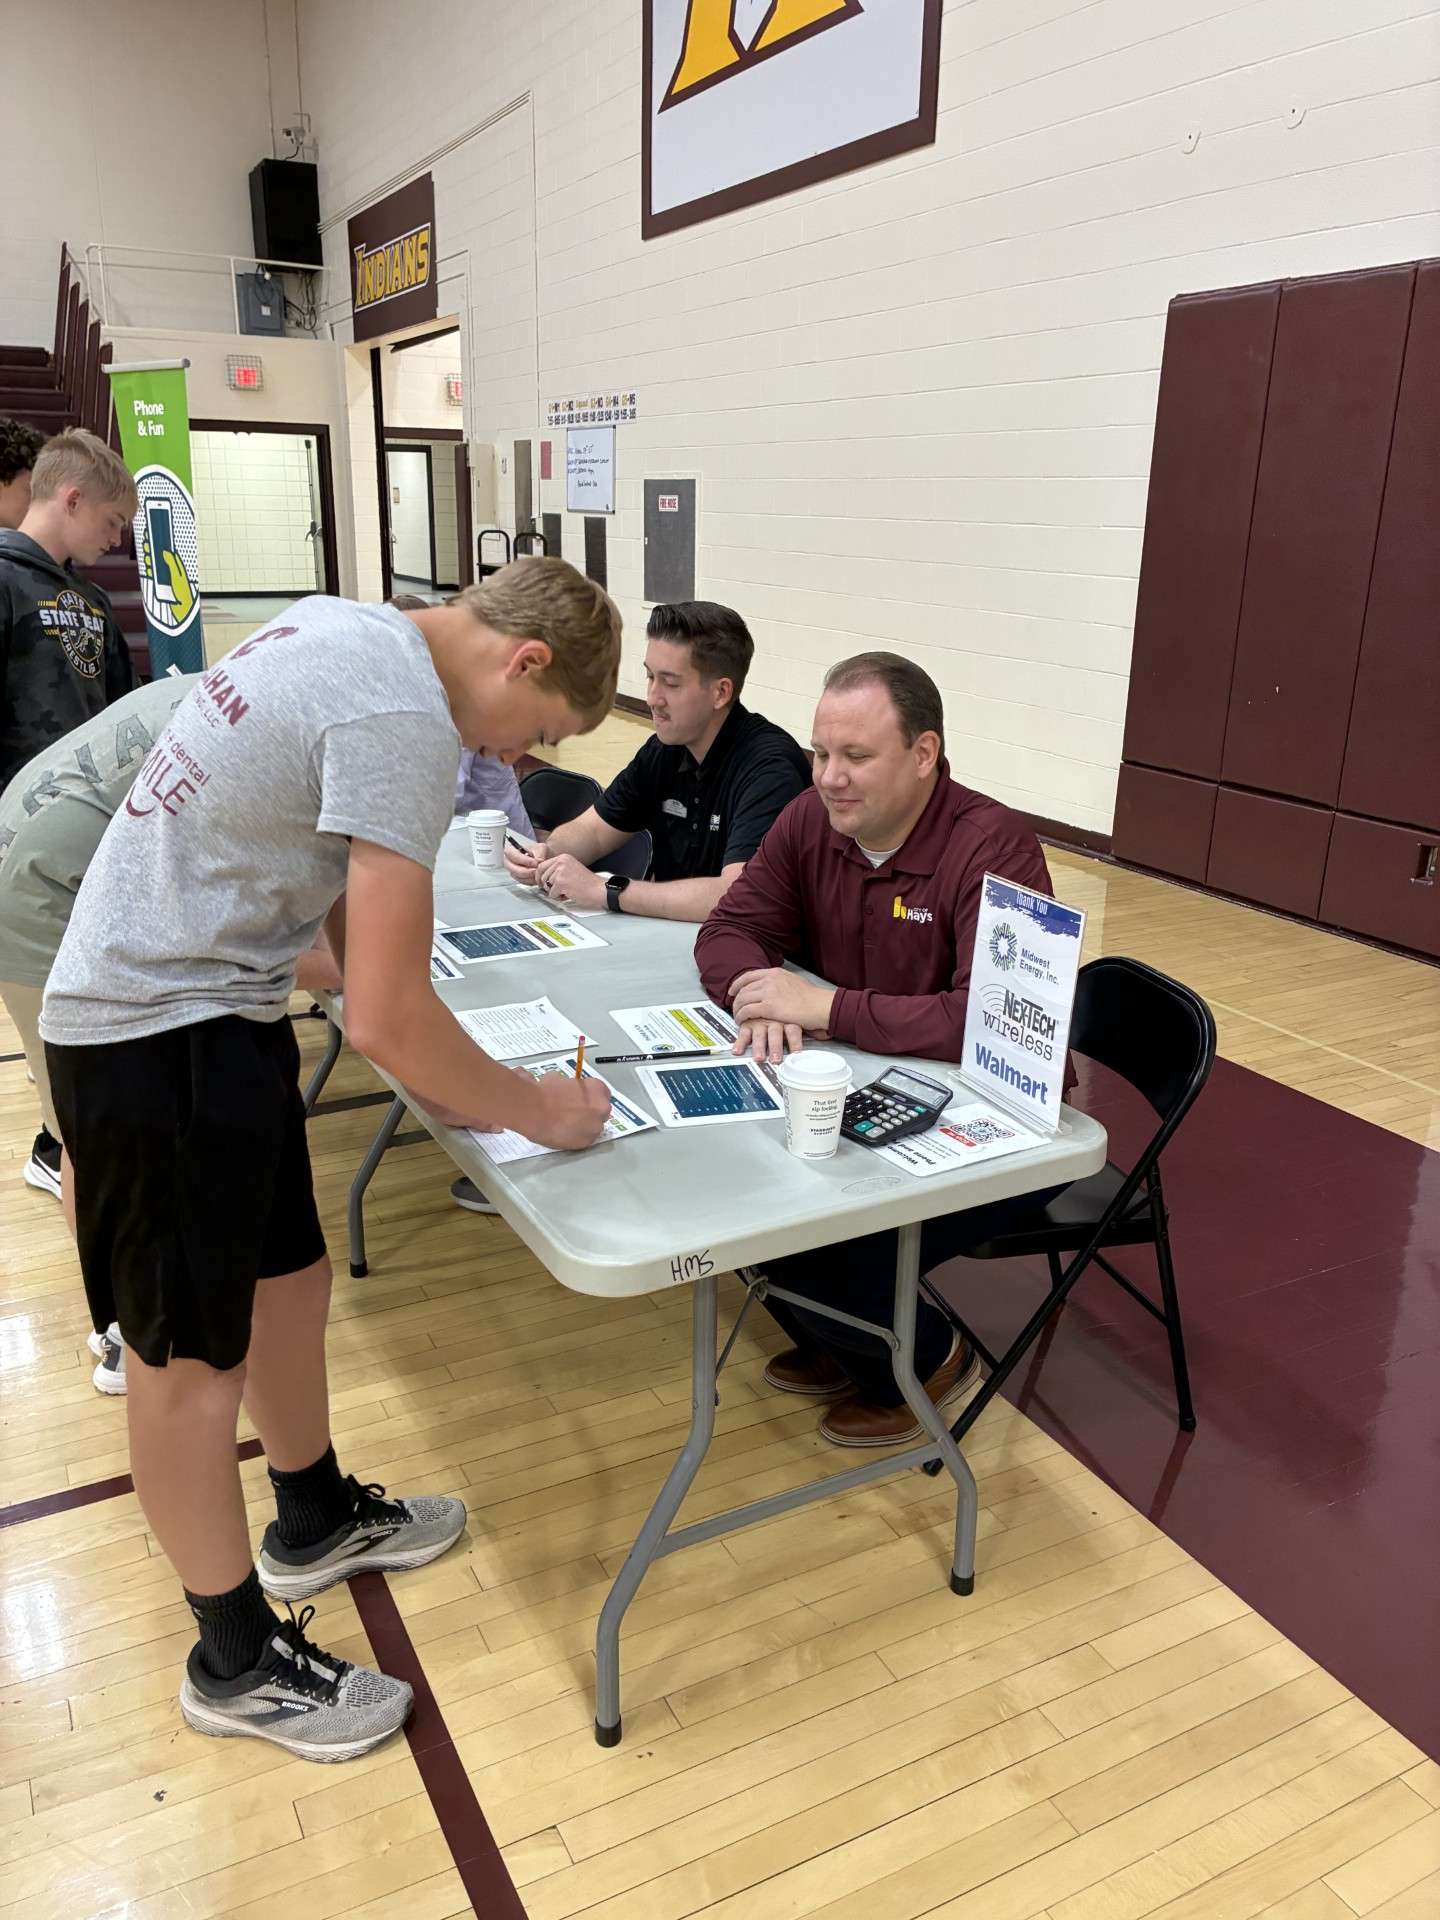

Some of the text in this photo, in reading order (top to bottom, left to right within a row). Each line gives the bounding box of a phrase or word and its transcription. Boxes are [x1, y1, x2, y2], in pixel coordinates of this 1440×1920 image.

[355, 226, 430, 308] INDIANS
[133, 400, 164, 416] Phone
[137, 420, 165, 436] & Fun
[39, 609, 80, 627] STATE
[169, 741, 212, 786] dental
[907, 908, 933, 924] Hays
[1021, 948, 1050, 969] Midwest
[1019, 959, 1060, 985] Energy, Inc.
[982, 1010, 1054, 1062] wireless
[976, 1042, 1049, 1105] Walmart
[281, 1700, 309, 1713] BROOKS
